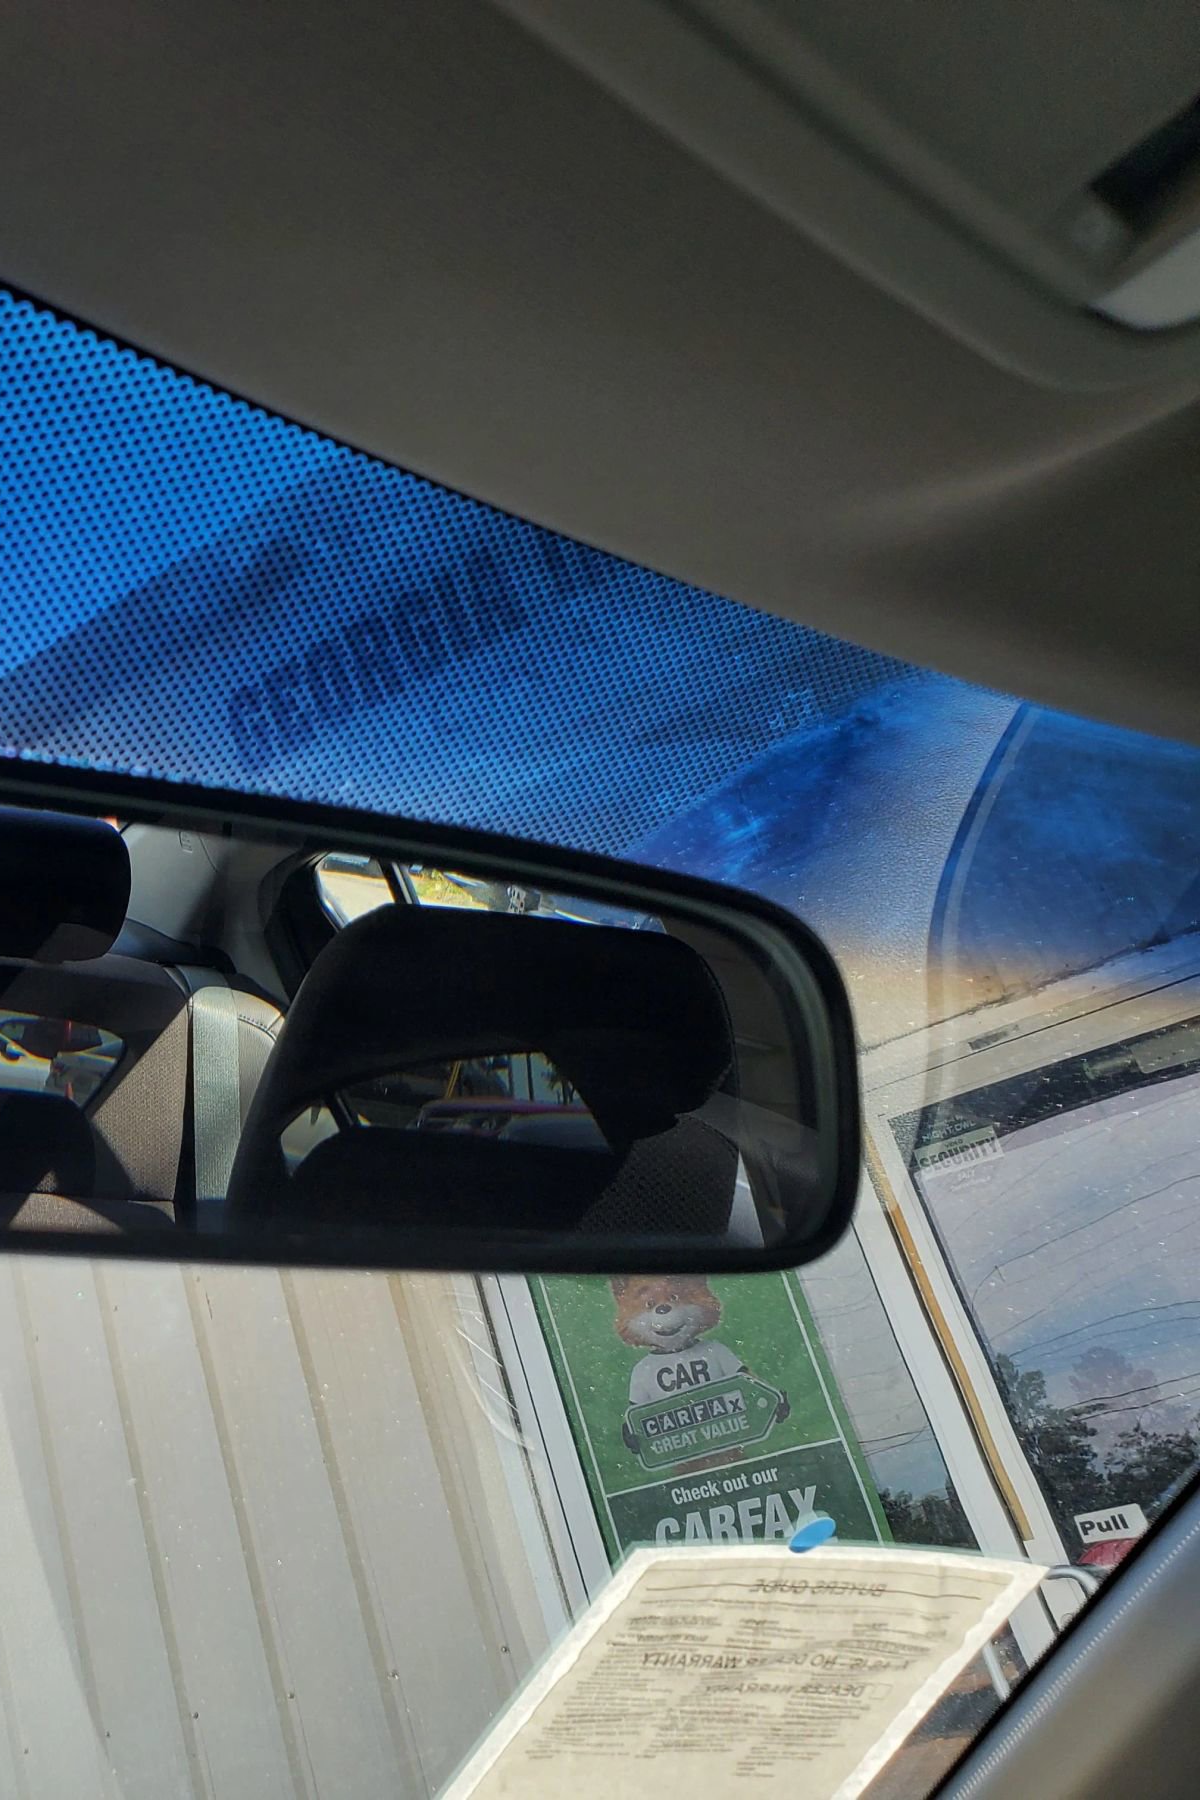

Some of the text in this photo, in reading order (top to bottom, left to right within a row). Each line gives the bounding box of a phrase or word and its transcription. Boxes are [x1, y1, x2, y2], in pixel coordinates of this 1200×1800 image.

[227, 548, 529, 770] GEORGIA
[919, 1136, 998, 1174] SECURITY
[656, 1359, 711, 1392] CAR
[644, 1394, 746, 1436] CARFAX
[652, 1415, 750, 1455] GREAT VALUE
[671, 1467, 779, 1505] Check out our
[1079, 1513, 1130, 1536] Pull
